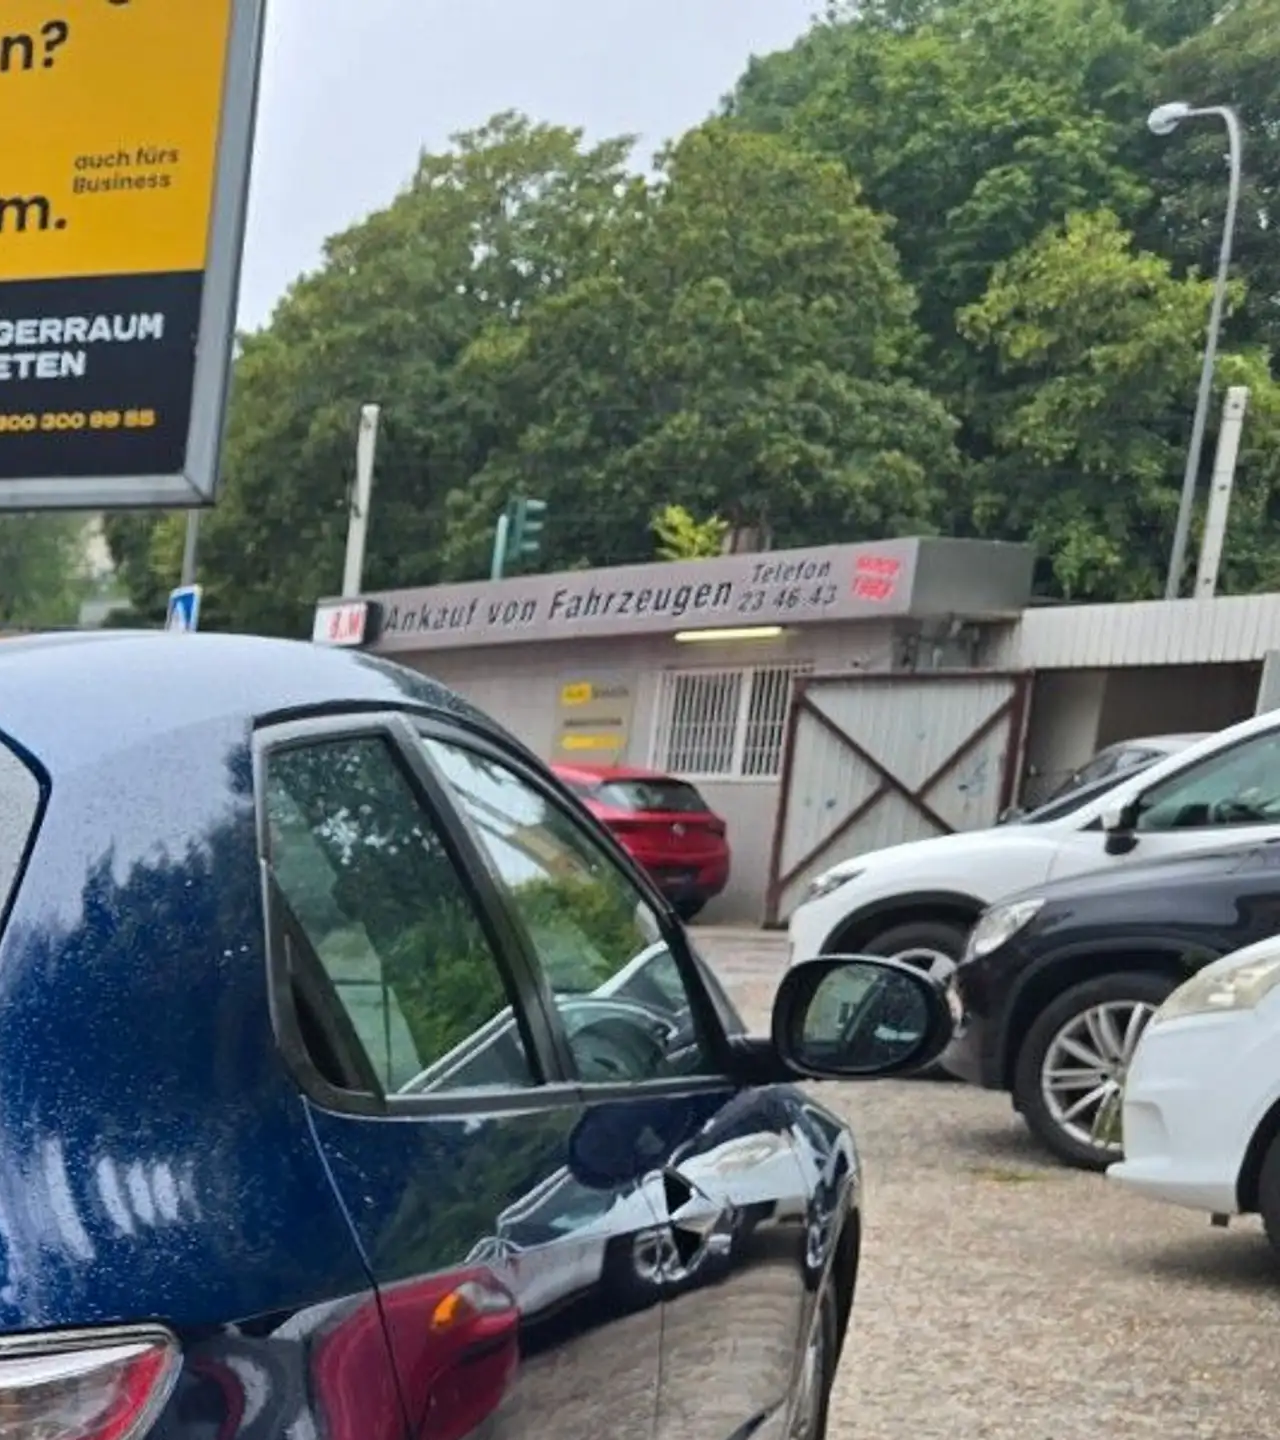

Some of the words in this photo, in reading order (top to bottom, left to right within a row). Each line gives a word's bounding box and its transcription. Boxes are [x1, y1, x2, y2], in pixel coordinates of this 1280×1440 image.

[74, 147, 130, 171] auch
[73, 172, 172, 194] Business
[752, 560, 832, 583] Telefon
[384, 598, 476, 632] Ankauf
[488, 599, 536, 625] von
[548, 581, 733, 621] Fahrzeugen
